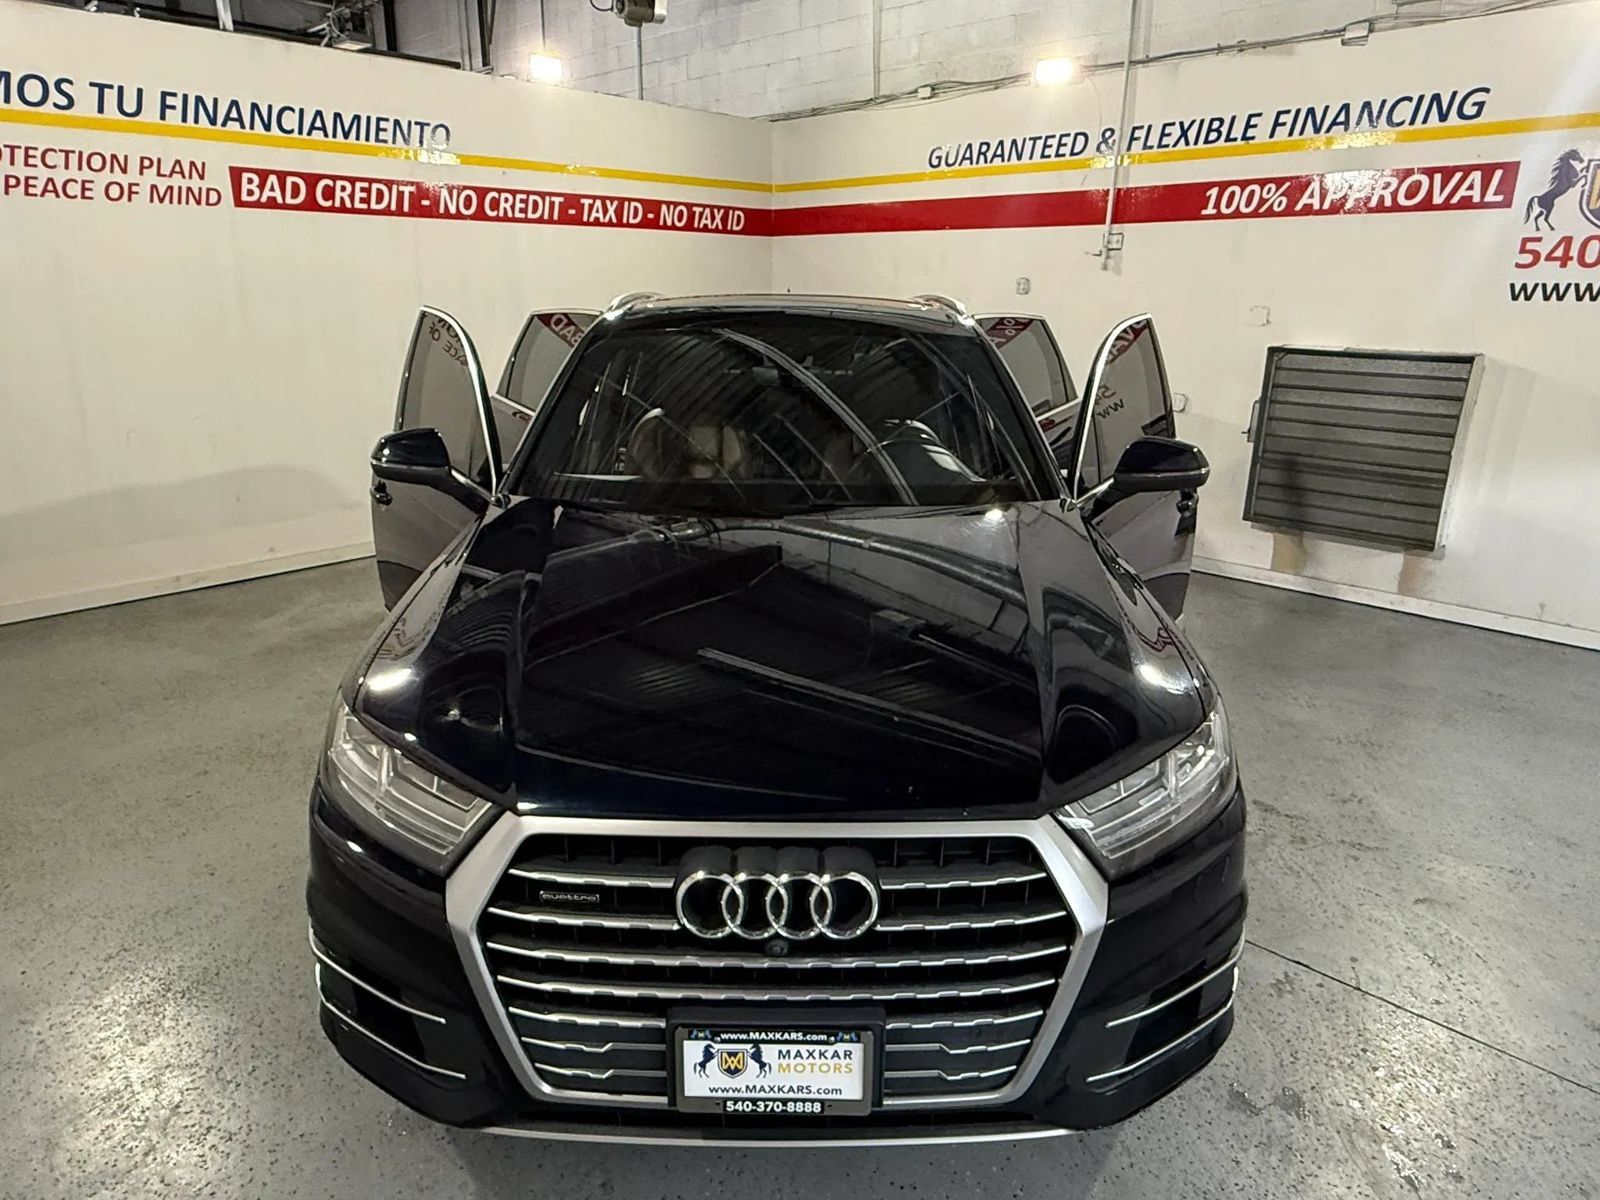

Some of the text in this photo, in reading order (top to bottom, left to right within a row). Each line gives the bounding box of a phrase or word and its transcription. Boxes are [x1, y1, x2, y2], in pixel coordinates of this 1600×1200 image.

[0, 71, 450, 149] OS TU FINANCIAMIENTO
[928, 87, 1491, 169] GUARANTEED & FLEXIBLE FINANCING
[0, 144, 206, 180] TECTION PLAN
[4, 174, 222, 206] PEACE OF MIND
[240, 172, 307, 205] BAD
[315, 179, 415, 212] CREDIT
[439, 188, 477, 216] NO
[484, 192, 564, 220] CREDIT
[580, 199, 617, 224] TAX
[622, 201, 643, 224] ID
[660, 204, 687, 227] NO
[692, 207, 723, 230] TAX
[727, 209, 745, 231] ID
[1201, 169, 1505, 216] 100% APPROVAL
[720, 1031, 827, 1041] www.MAXKARS.com
[777, 1049, 853, 1060] MAXKAR
[777, 1063, 853, 1073] MOTORS
[708, 1084, 843, 1096] www.MAXKARS.com
[726, 1101, 822, 1113] 540-370-8888
